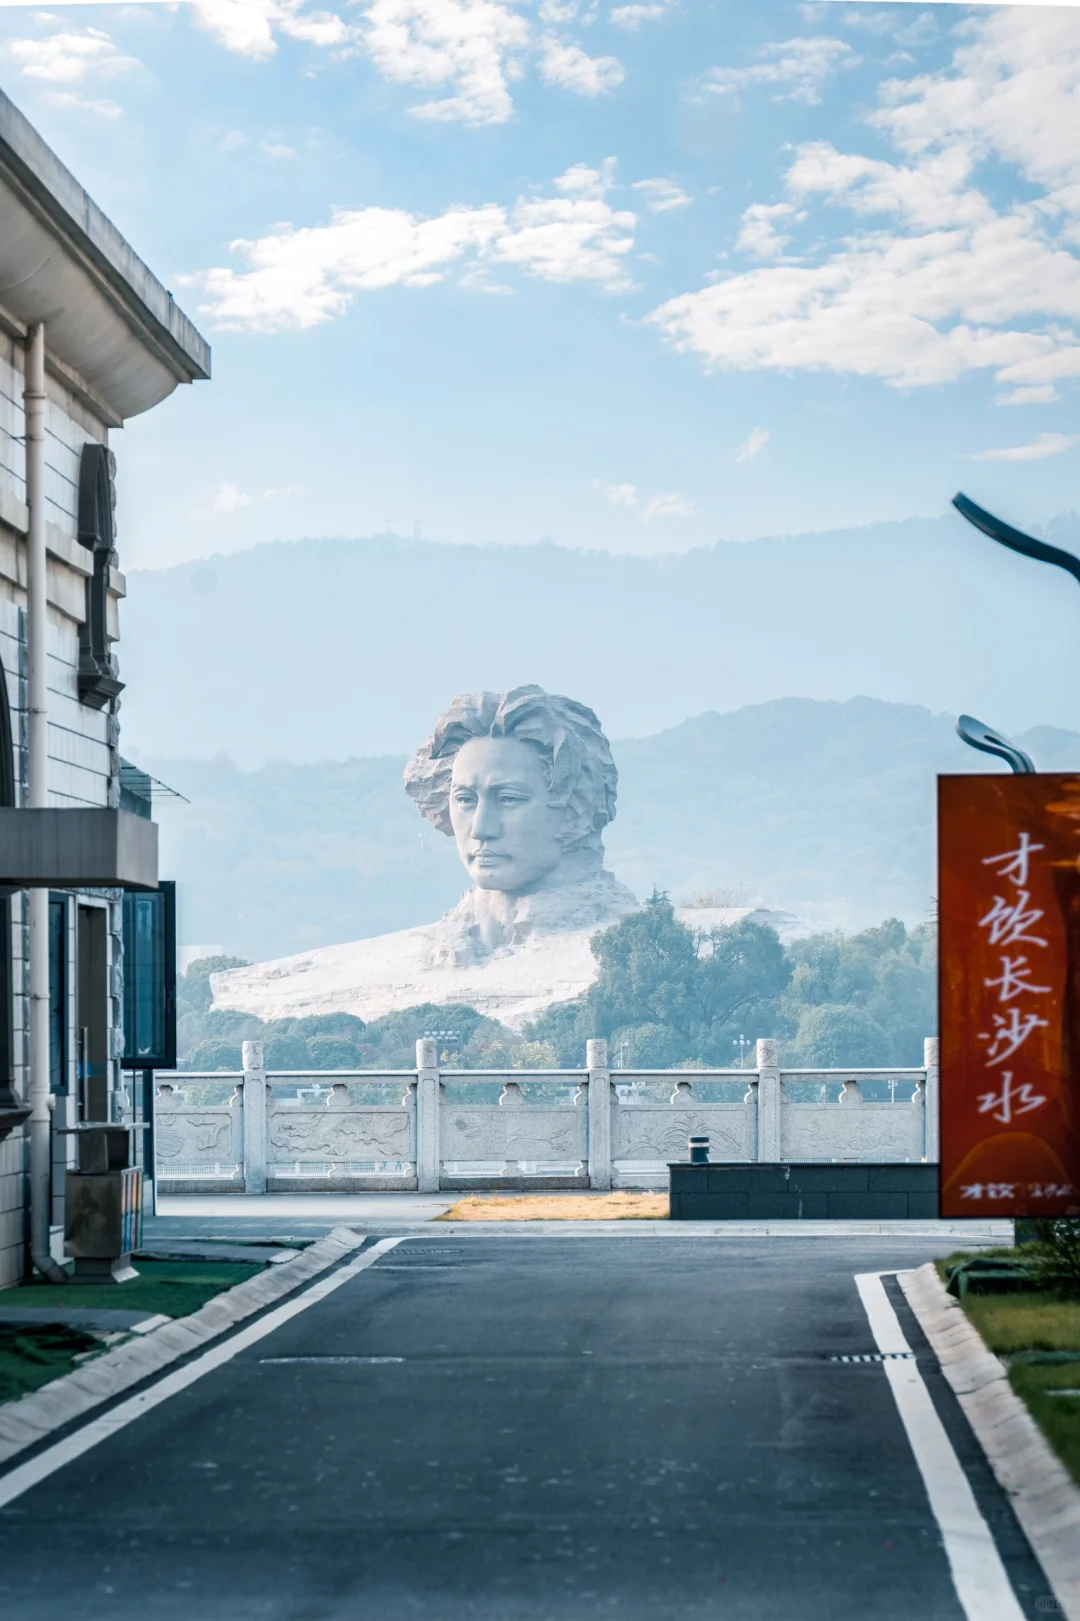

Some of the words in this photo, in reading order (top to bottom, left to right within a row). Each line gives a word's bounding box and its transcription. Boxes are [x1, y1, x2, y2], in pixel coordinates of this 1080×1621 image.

[977, 831, 1051, 1125] 才饮长沙水
